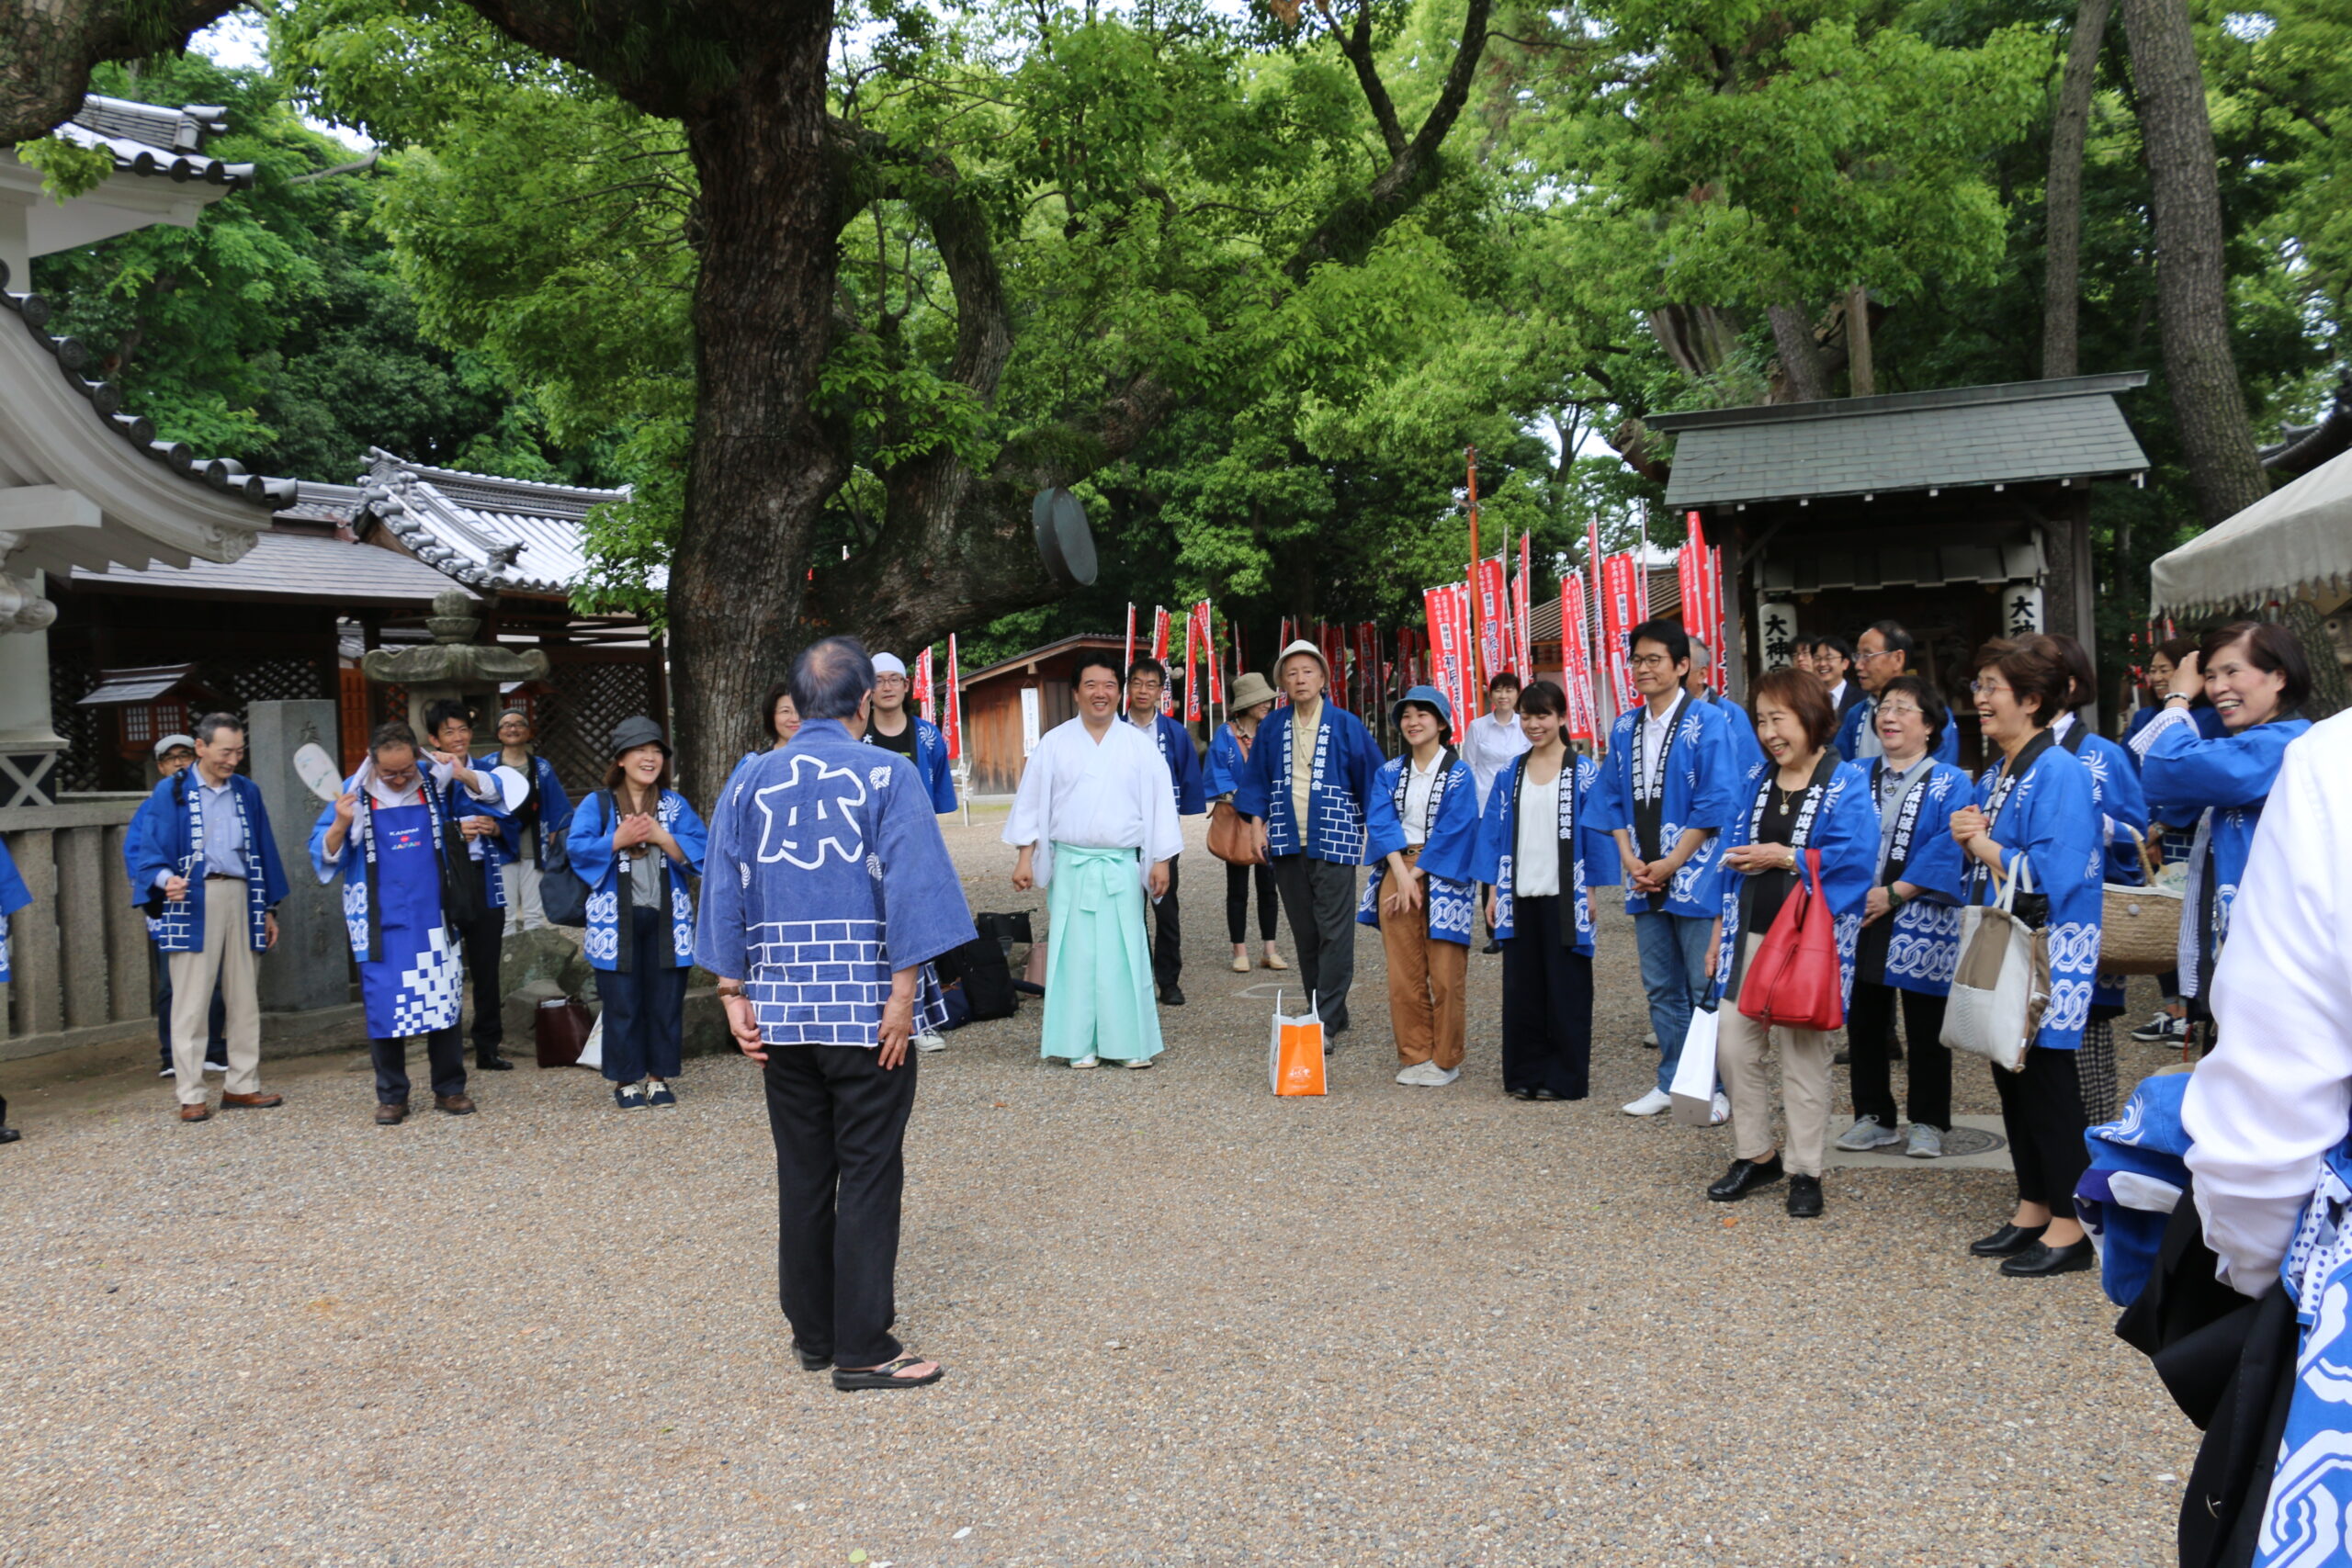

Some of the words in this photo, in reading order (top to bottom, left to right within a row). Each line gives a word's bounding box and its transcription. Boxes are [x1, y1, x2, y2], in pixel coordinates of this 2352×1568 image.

[1311, 723, 1331, 791] 大阪出版協会
[1559, 766, 1573, 840] 大阪出版協会
